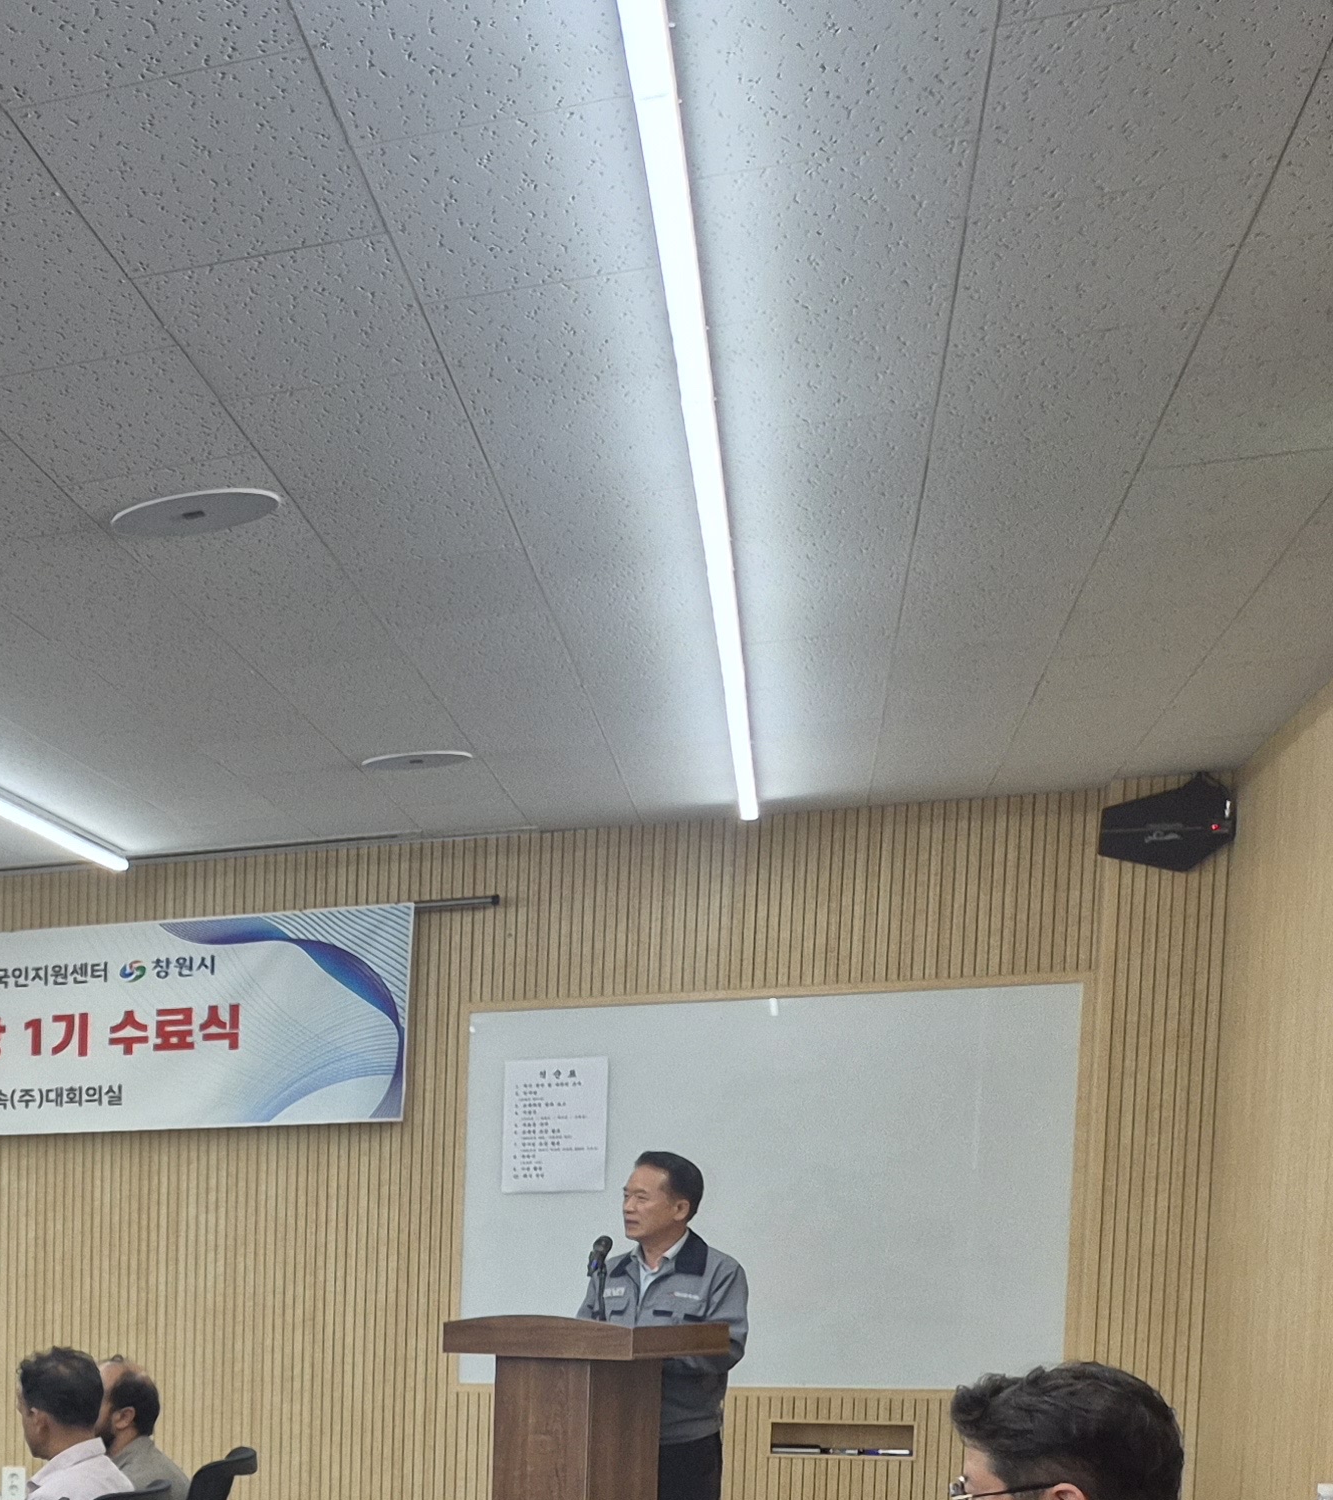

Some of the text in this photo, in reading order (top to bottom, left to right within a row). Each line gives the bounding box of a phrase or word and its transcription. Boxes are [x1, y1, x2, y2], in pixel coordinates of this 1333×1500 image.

[151, 954, 217, 980] 창원시
[23, 1012, 90, 1058] 1기
[107, 1002, 242, 1056] 수료식
